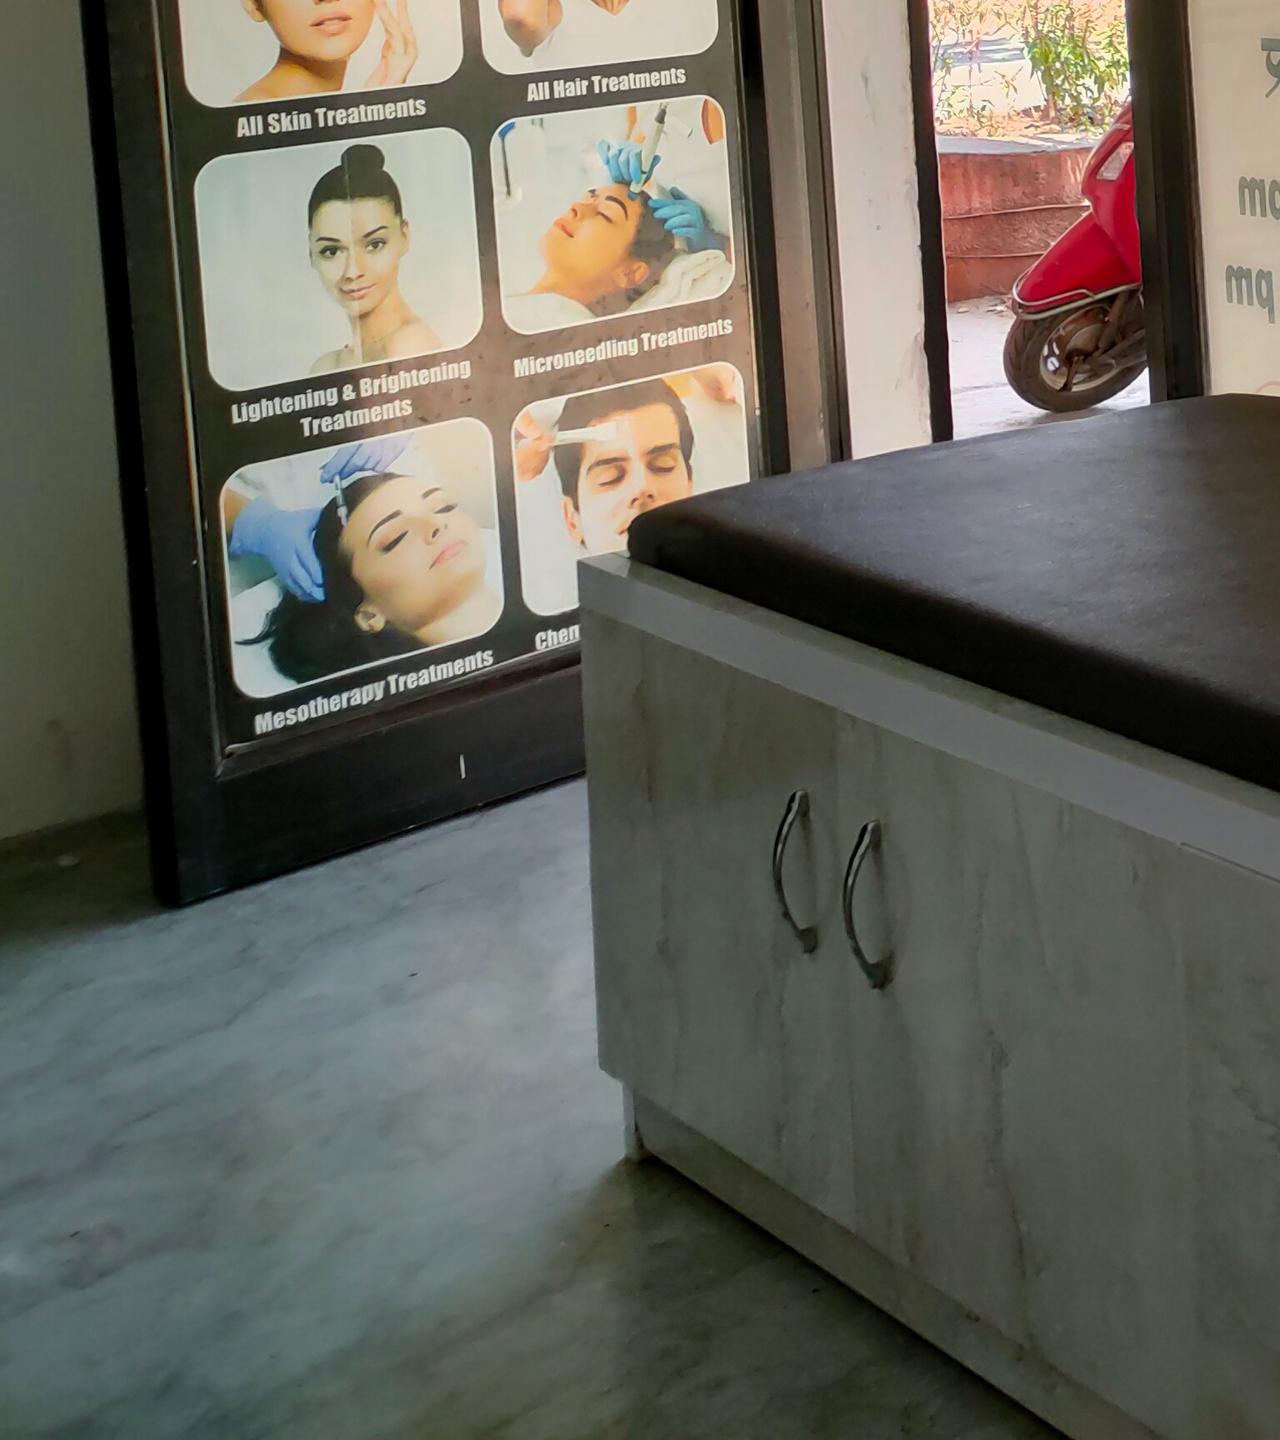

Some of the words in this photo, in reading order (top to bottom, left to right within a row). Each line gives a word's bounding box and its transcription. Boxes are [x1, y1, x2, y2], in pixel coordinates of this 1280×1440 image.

[526, 80, 551, 102] All
[552, 76, 589, 99] Hair
[590, 65, 687, 95] Treatments
[236, 113, 264, 138] All
[267, 108, 312, 135] Skin
[314, 96, 427, 130] Treatments
[513, 335, 639, 379] Microneedling
[641, 317, 733, 354] Treatments
[230, 383, 339, 425] Lightening
[341, 380, 356, 402] &
[358, 358, 472, 399] Brightening
[300, 397, 413, 439] Treatments
[254, 680, 385, 734] Mesotherapy
[387, 647, 494, 697] Treatments
